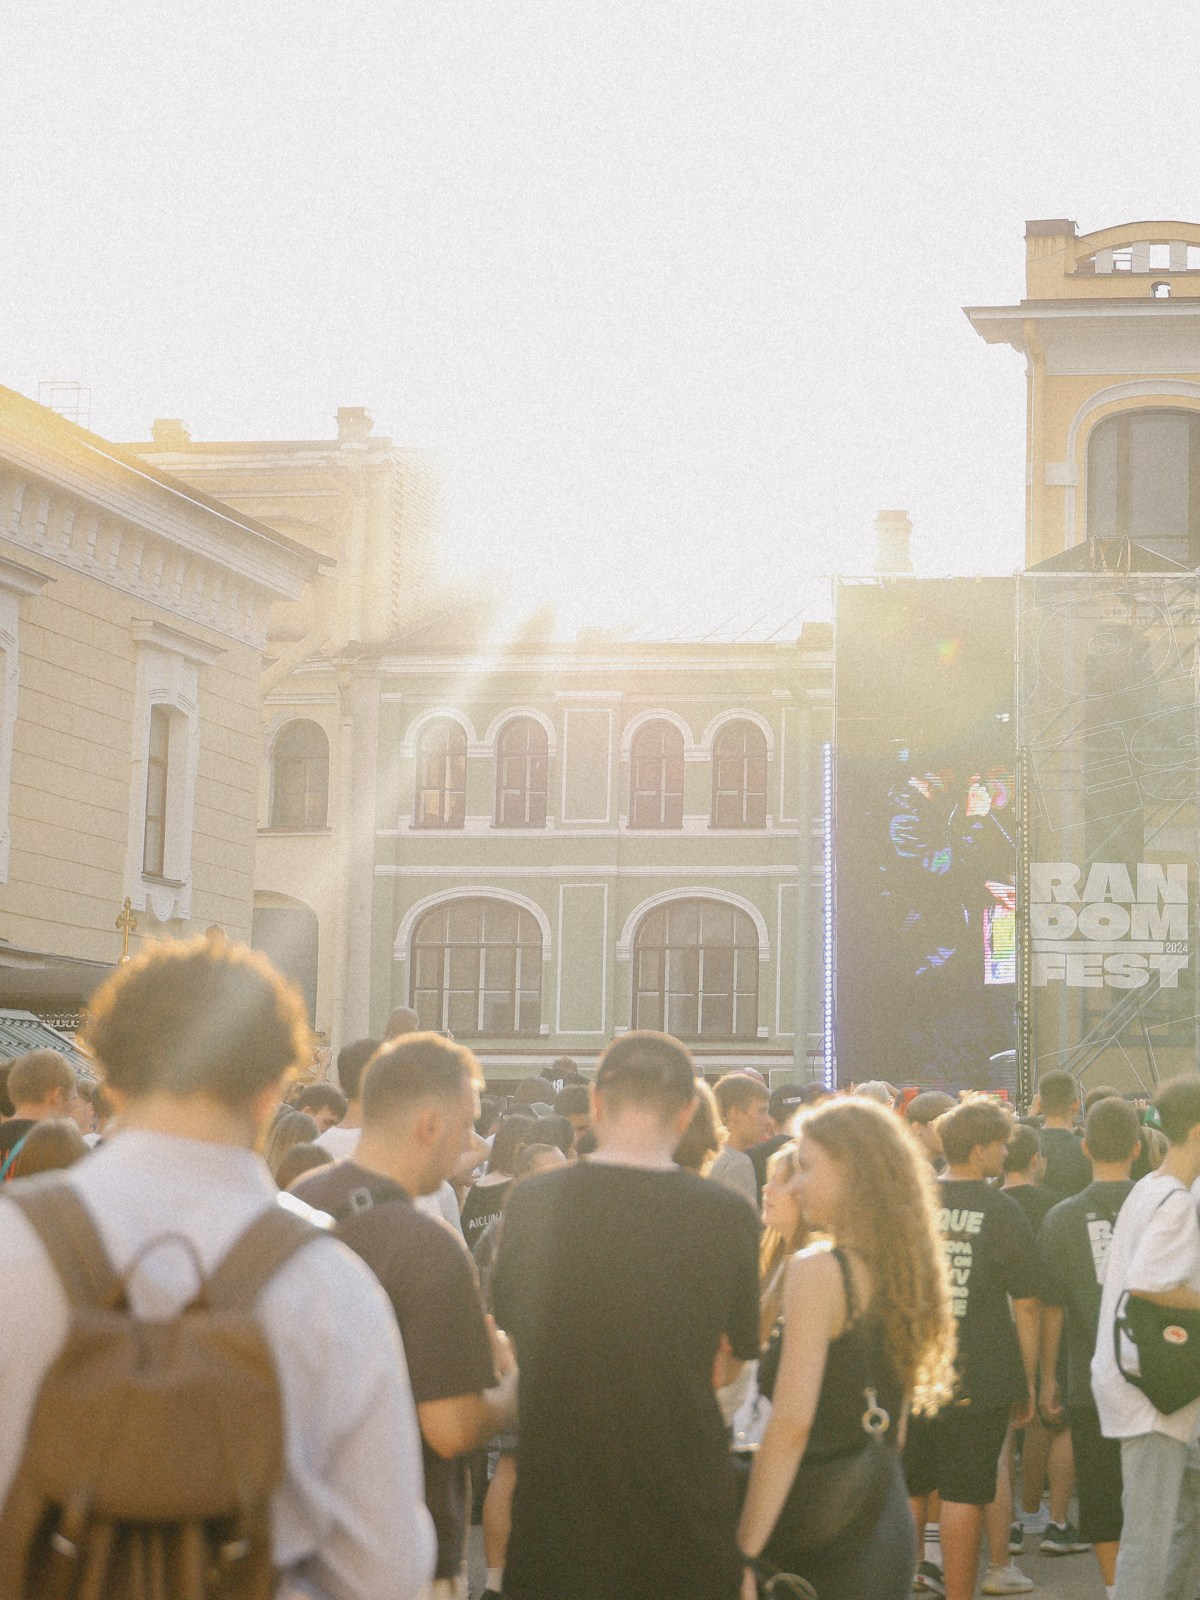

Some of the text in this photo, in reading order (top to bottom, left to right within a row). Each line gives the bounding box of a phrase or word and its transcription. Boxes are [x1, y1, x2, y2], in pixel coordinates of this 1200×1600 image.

[1030, 862, 1189, 904] RAN
[1030, 902, 1189, 941] DOM
[1165, 942, 1189, 954] 2024
[1031, 953, 1189, 989] FEST
